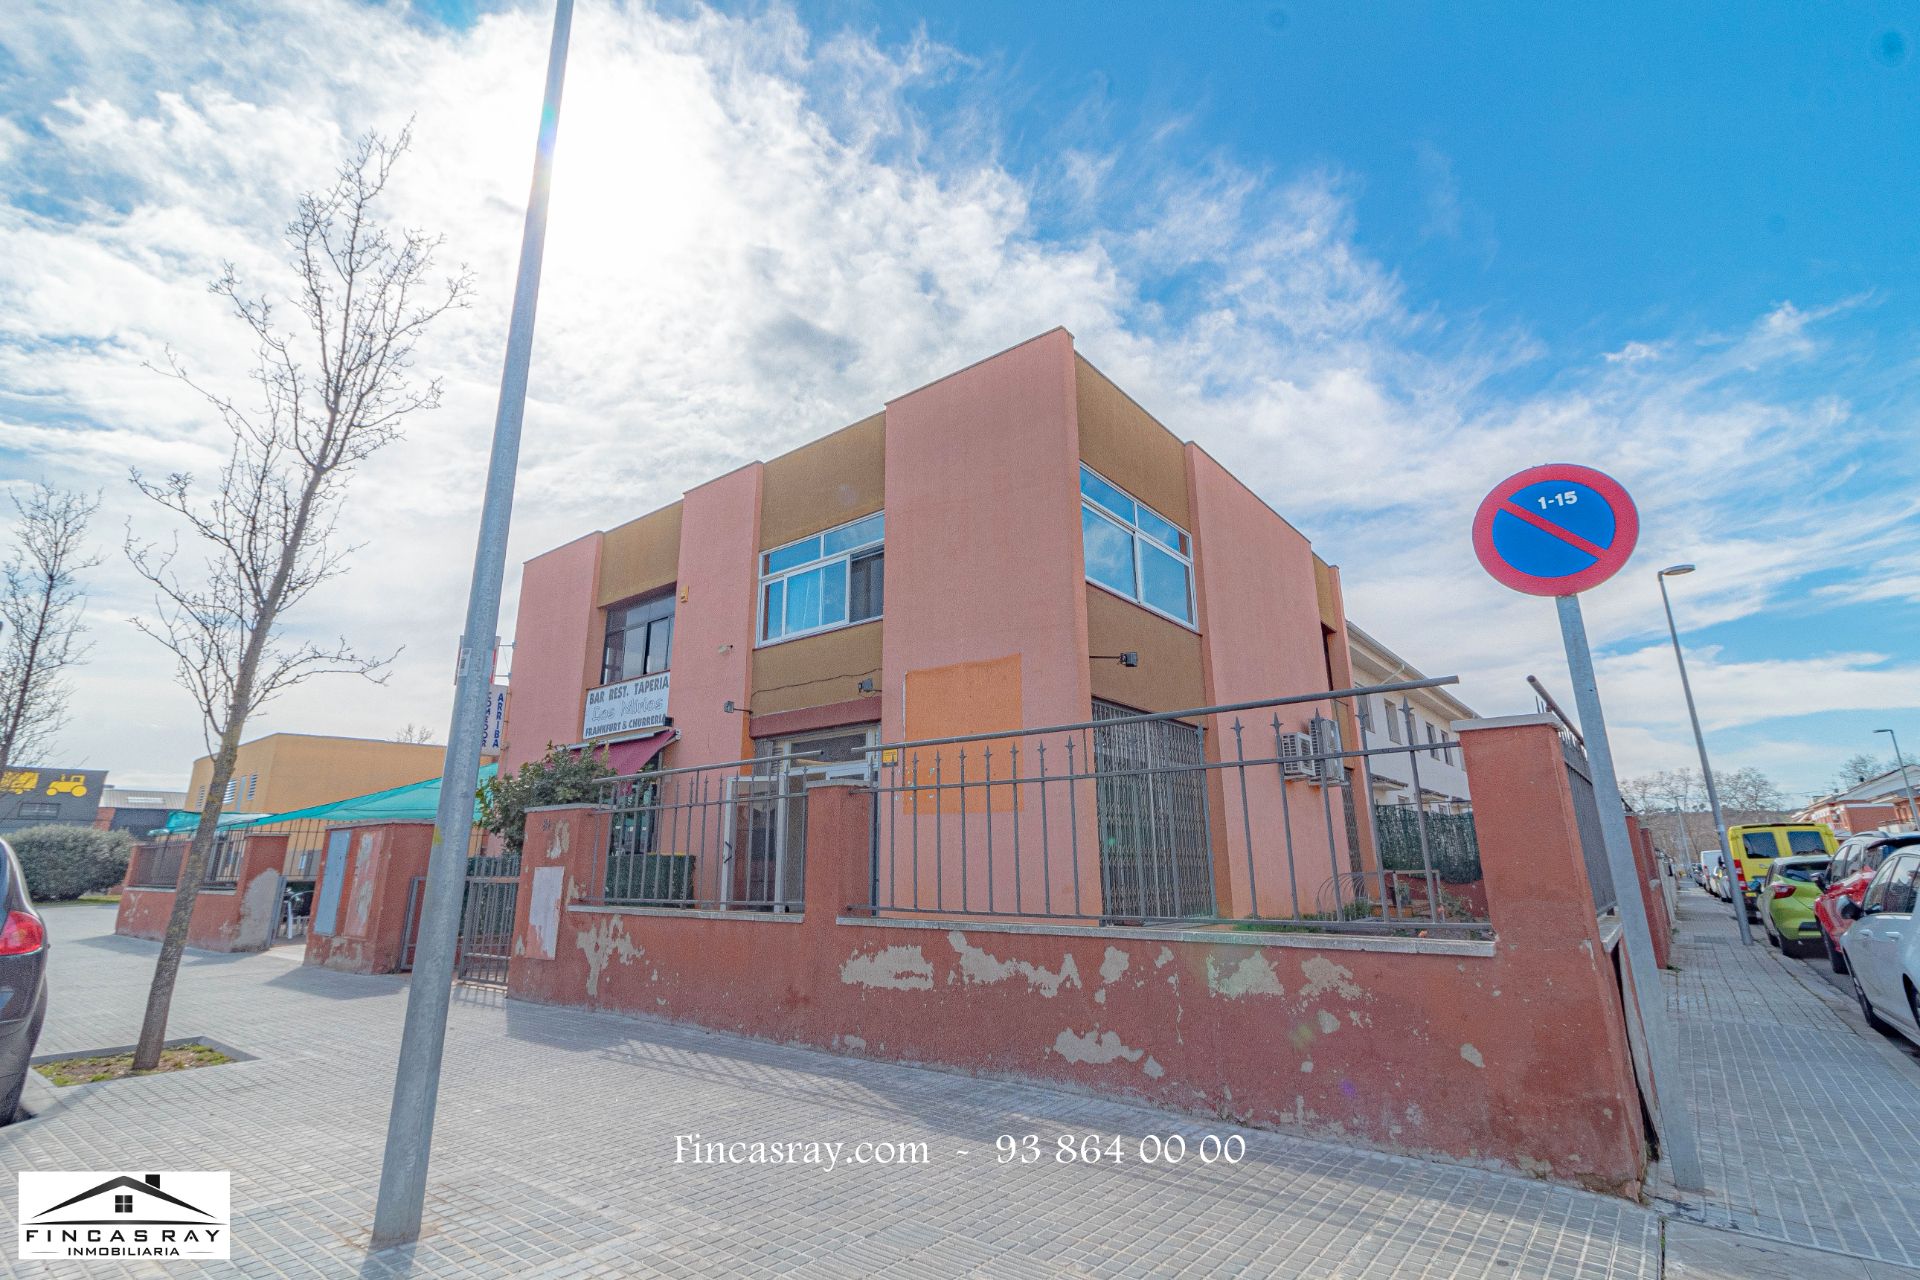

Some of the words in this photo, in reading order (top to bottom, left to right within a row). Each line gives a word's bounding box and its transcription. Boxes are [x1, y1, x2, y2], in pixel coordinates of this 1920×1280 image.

[1538, 490, 1578, 510] 1-15
[589, 690, 605, 705] BAR
[608, 685, 629, 701] REST.
[634, 675, 669, 695] TAPERIA
[492, 692, 504, 748] ARRIBA
[585, 721, 621, 737] FRANKFURT
